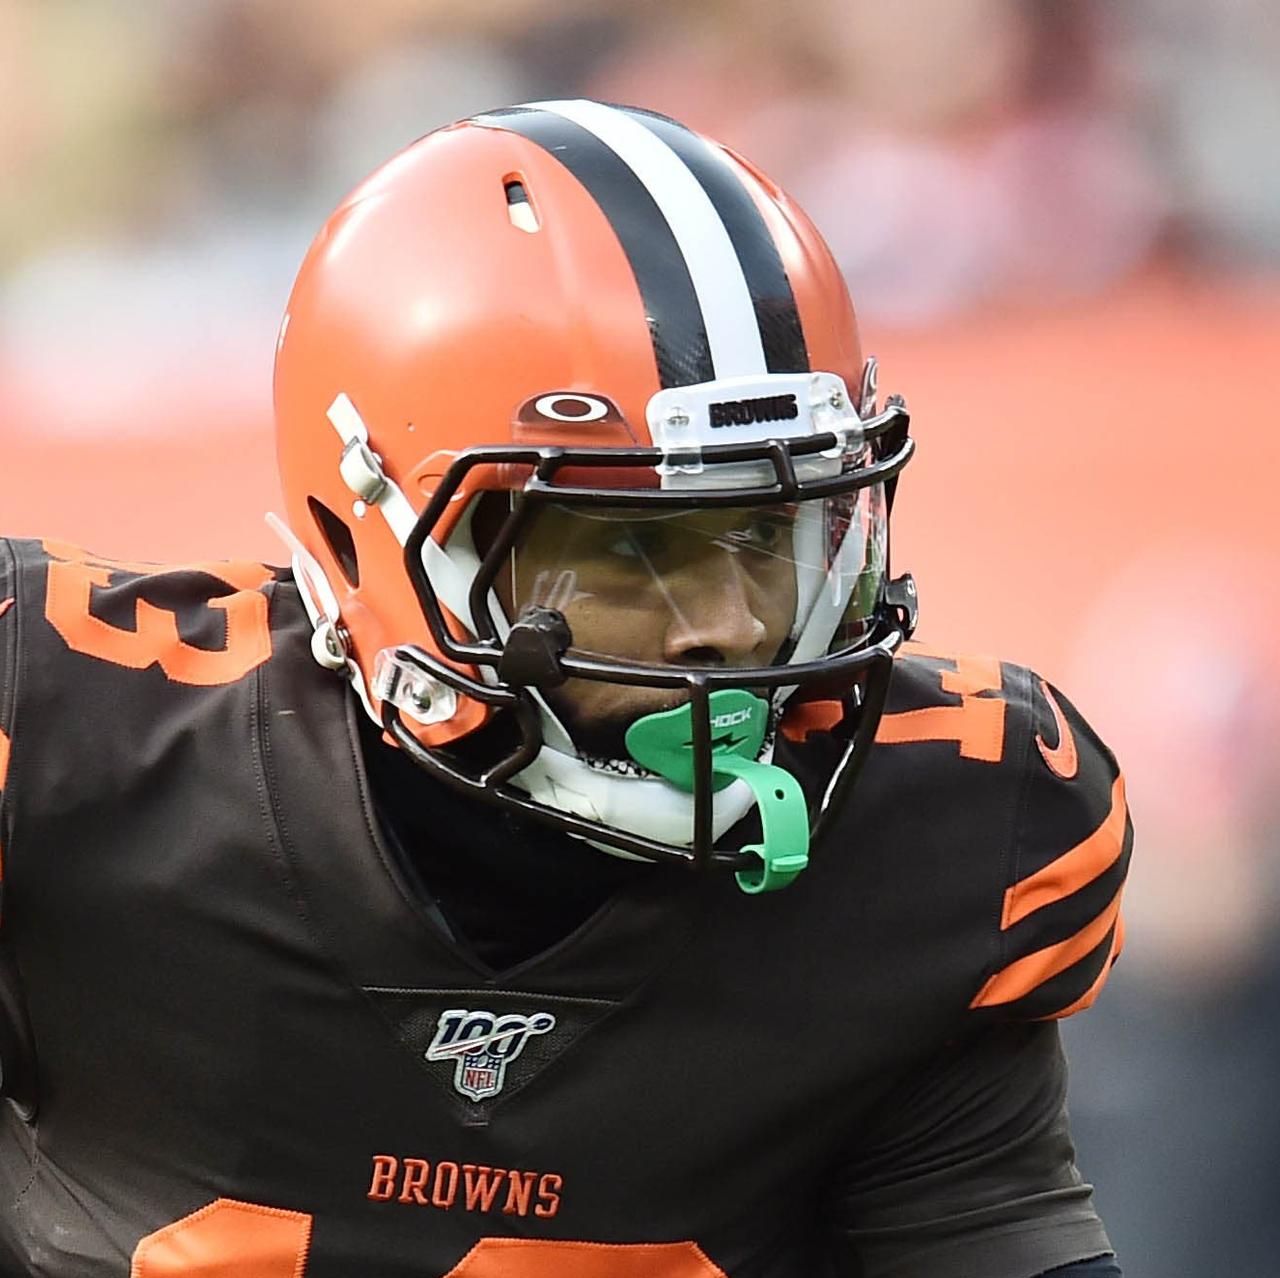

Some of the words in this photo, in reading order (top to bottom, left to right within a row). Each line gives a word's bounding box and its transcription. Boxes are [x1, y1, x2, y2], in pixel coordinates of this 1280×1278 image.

[709, 394, 798, 428] BROWNS
[709, 706, 752, 728] HOCK
[464, 1069, 497, 1090] NFL
[367, 1155, 563, 1218] BROWNS
